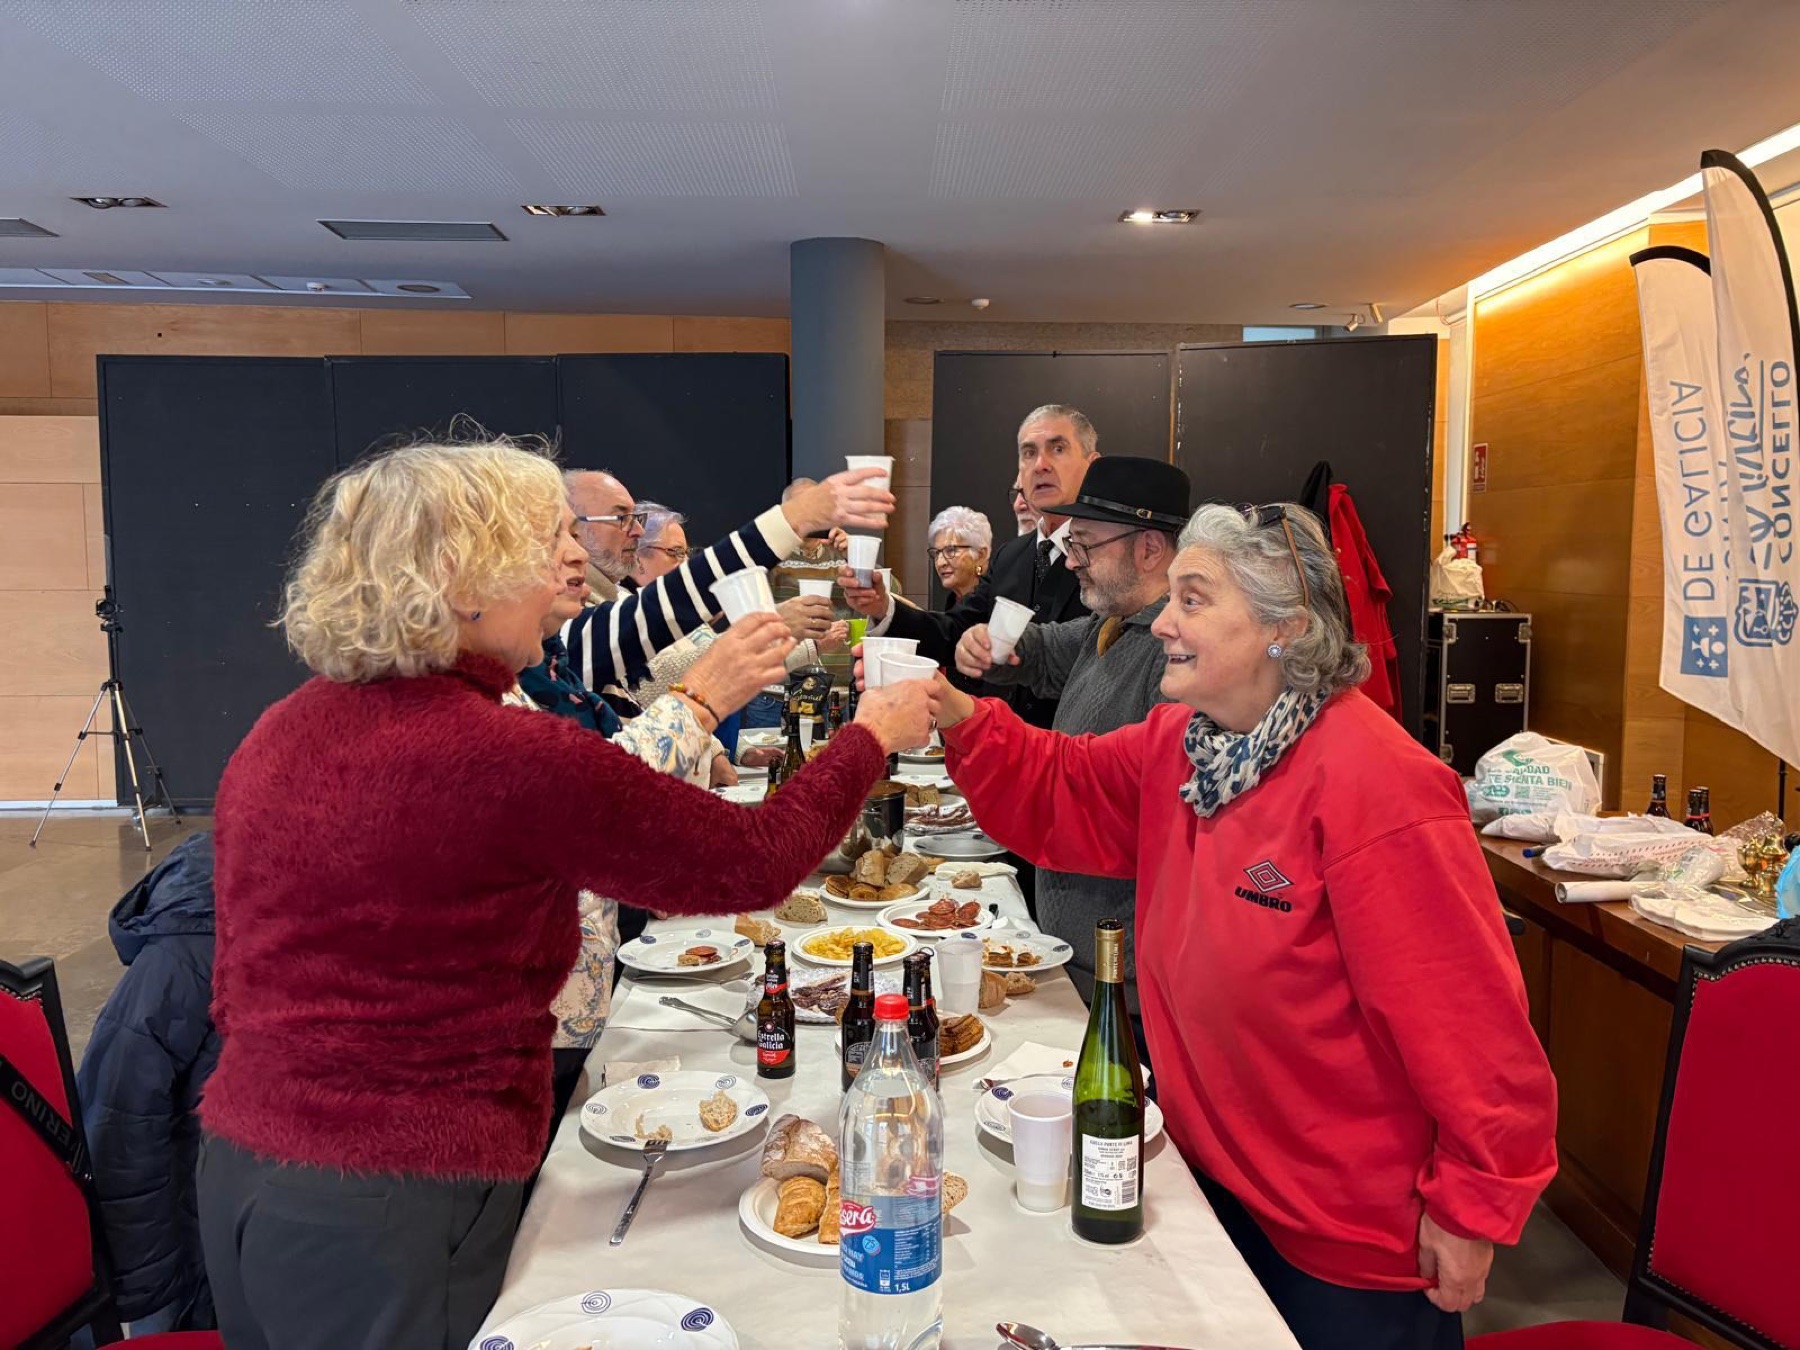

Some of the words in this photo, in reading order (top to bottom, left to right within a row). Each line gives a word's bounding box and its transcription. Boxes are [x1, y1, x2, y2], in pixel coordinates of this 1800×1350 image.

[1234, 886, 1292, 913] UMBRO
[757, 1031, 785, 1042] Estrella
[10, 1080, 76, 1151] ERINO
